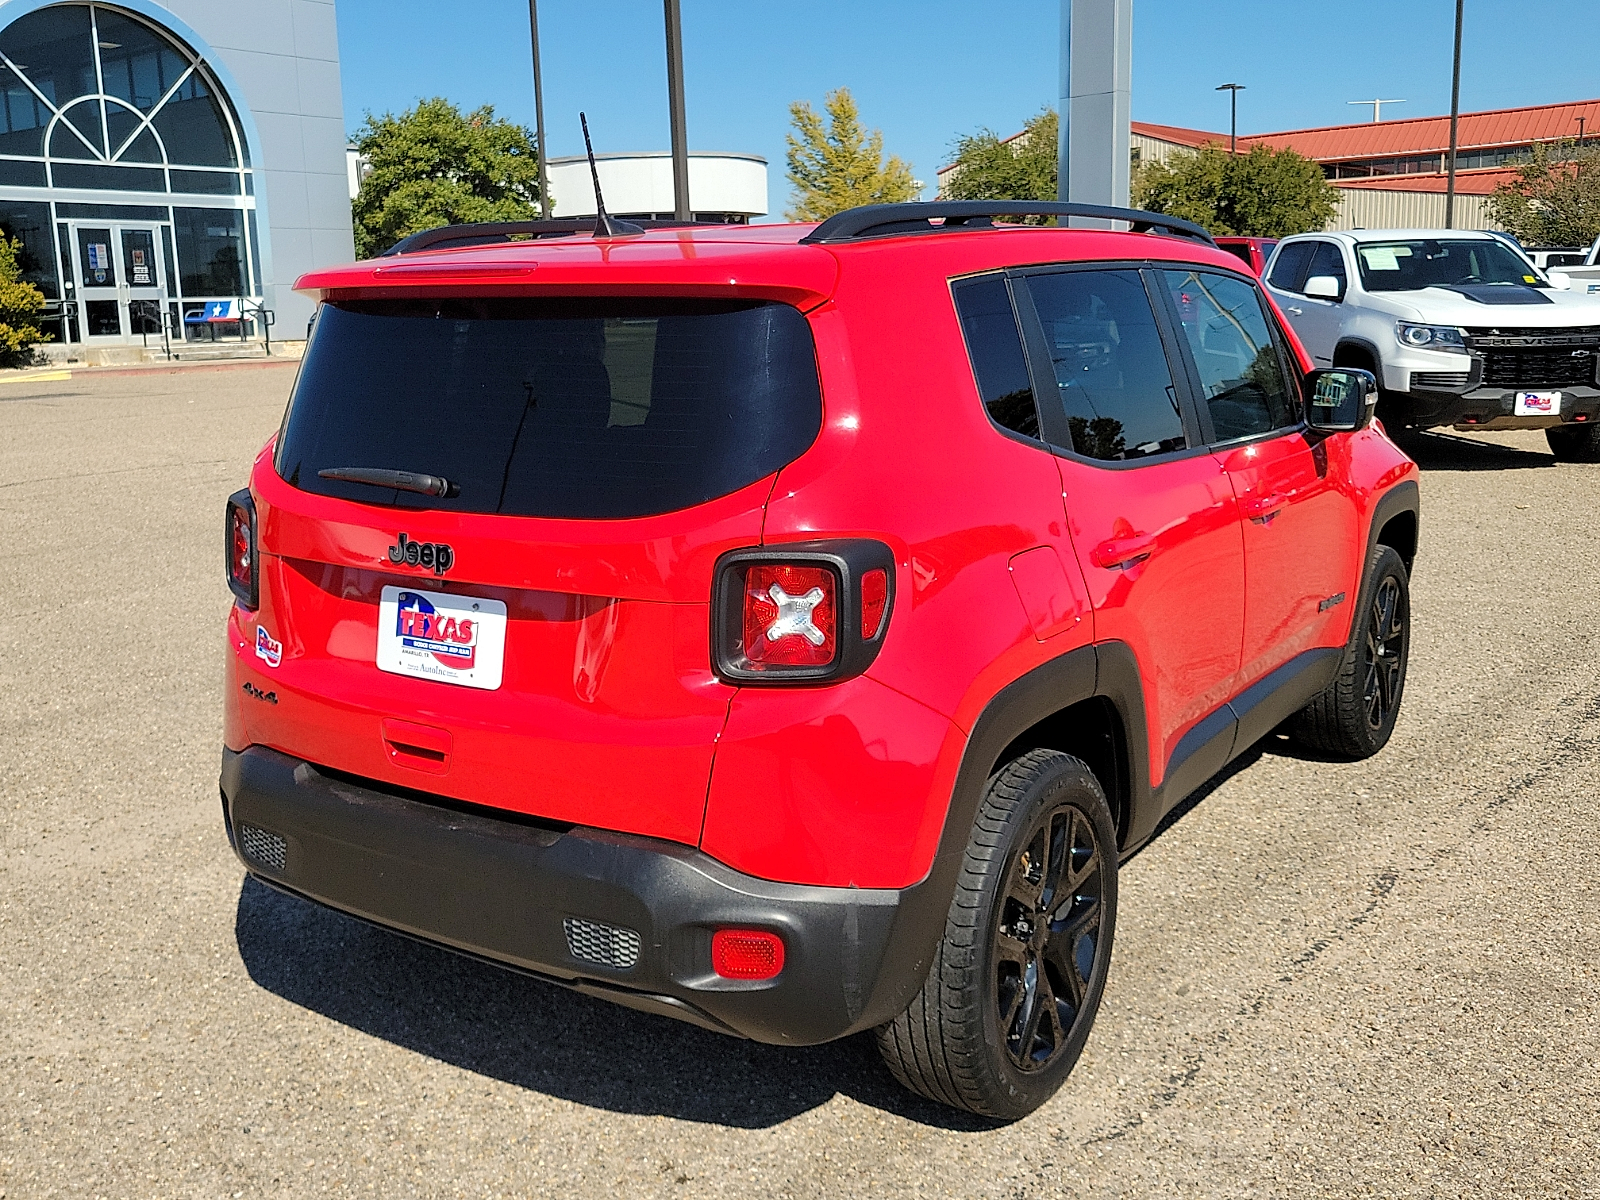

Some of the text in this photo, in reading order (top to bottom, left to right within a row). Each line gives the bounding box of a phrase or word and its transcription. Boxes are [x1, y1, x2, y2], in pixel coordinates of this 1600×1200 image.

[388, 533, 453, 575] Jeep
[400, 609, 473, 644] TEXAS
[420, 663, 446, 676] AutoInc
